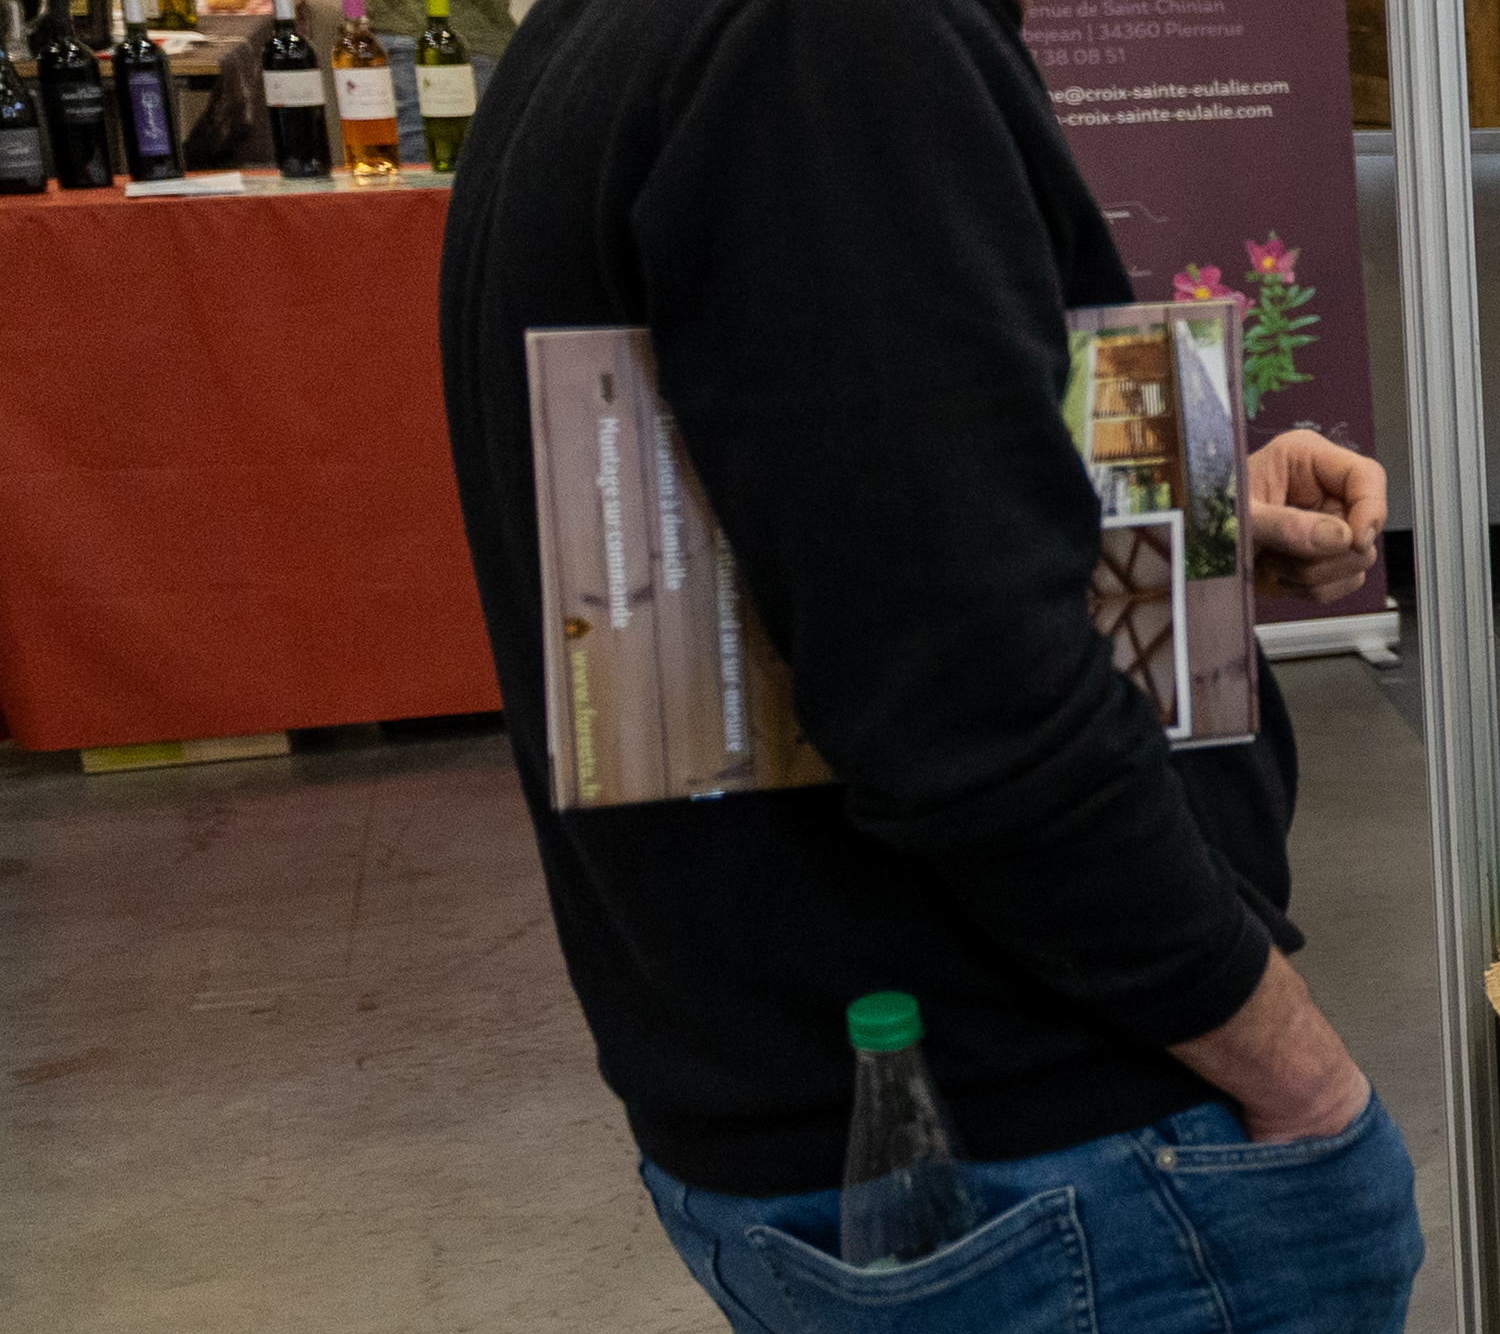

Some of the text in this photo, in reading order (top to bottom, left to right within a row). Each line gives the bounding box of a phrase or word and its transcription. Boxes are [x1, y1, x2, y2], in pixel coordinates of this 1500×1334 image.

[1028, 5, 1072, 18] enue
[1049, 78, 1291, 106] e@croix-sainte-eulalie.com
[1057, 102, 1274, 127] -croix-sainte-eulalie.com
[598, 417, 622, 498] Montage
